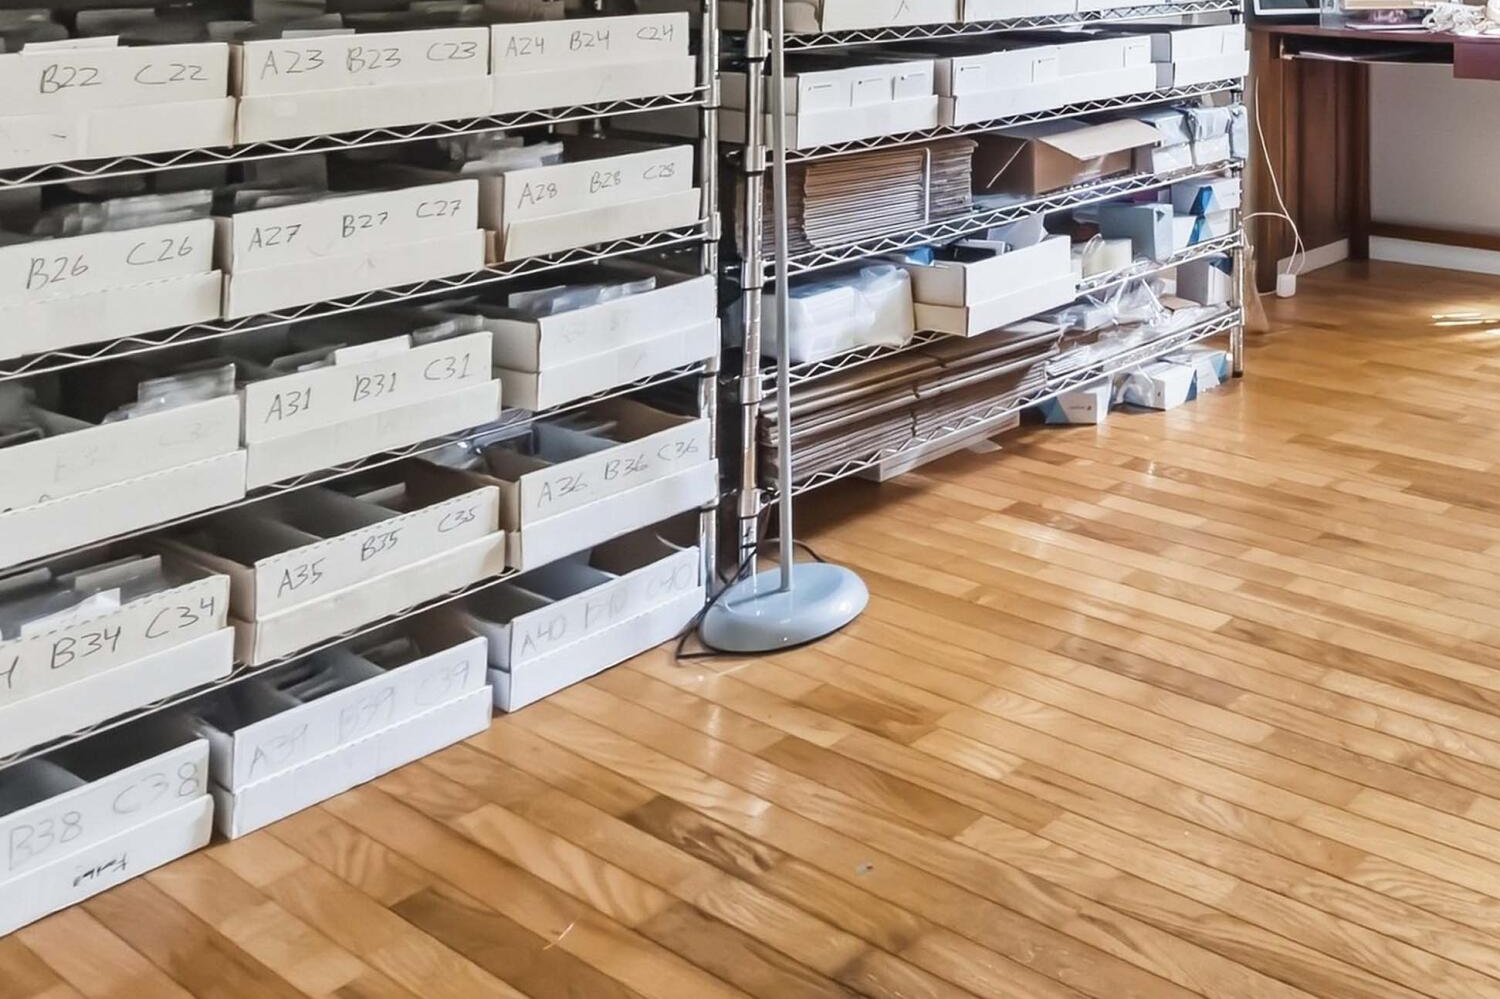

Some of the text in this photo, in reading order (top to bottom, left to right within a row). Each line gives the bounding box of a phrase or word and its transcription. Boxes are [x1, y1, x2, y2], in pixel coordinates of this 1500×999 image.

[261, 41, 477, 79] A23 B23 C23
[505, 24, 674, 56] A24 B24 C24
[40, 64, 209, 94] B22 C22
[517, 183, 557, 209] A28
[590, 171, 621, 193] B28
[248, 199, 462, 252] A27 B27 C27
[26, 237, 193, 289] B26 C26
[265, 353, 471, 423] A31 B31 C31
[537, 439, 698, 508] A36 B36 C36
[277, 505, 477, 598] A35 B35 C35
[50, 596, 215, 669] B34 C34
[9, 811, 83, 871] B38
[113, 762, 200, 814] C38
